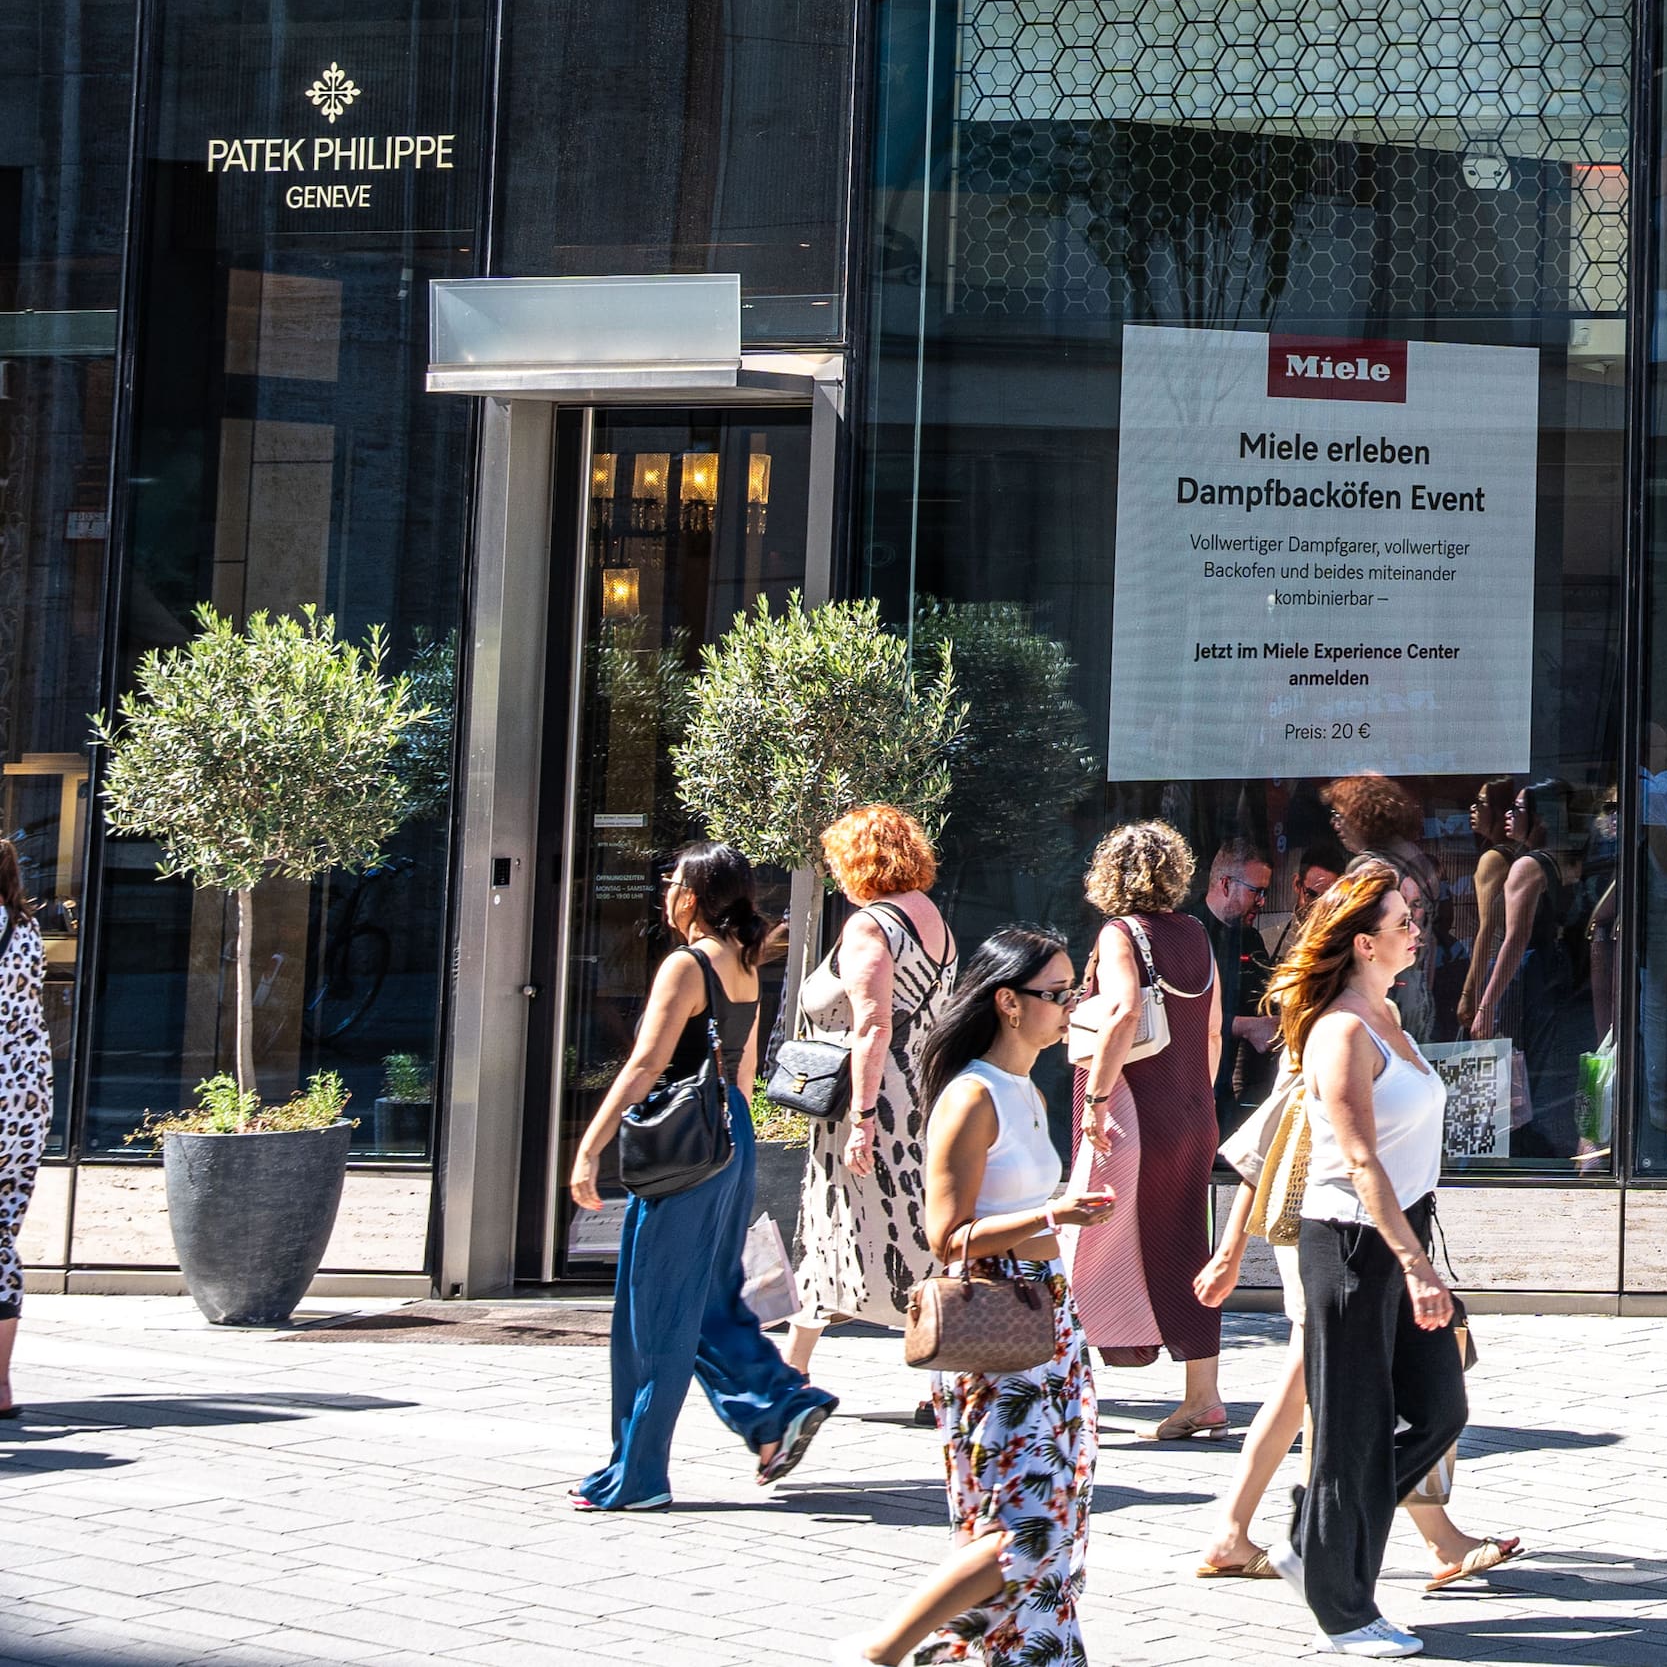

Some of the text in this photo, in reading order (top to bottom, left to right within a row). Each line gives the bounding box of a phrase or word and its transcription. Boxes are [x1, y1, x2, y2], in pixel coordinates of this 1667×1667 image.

[207, 134, 455, 173] PATEK PHILIPPE
[285, 184, 372, 209] GENEVE
[1285, 354, 1391, 382] Miele
[1239, 431, 1430, 465] Miele erleben
[1177, 476, 1485, 513] Dampfbacköfen Event
[1190, 533, 1471, 560] Vollwertiger Dampfgarer, vollwertiger
[1204, 561, 1457, 581] Backofen und beides miteinander
[1274, 588, 1375, 606] kombinierbar
[1193, 642, 1461, 663] Jetzt im Miele Experience Center
[1288, 669, 1369, 686] anmelden
[1285, 722, 1371, 740] Preis: 20 €
